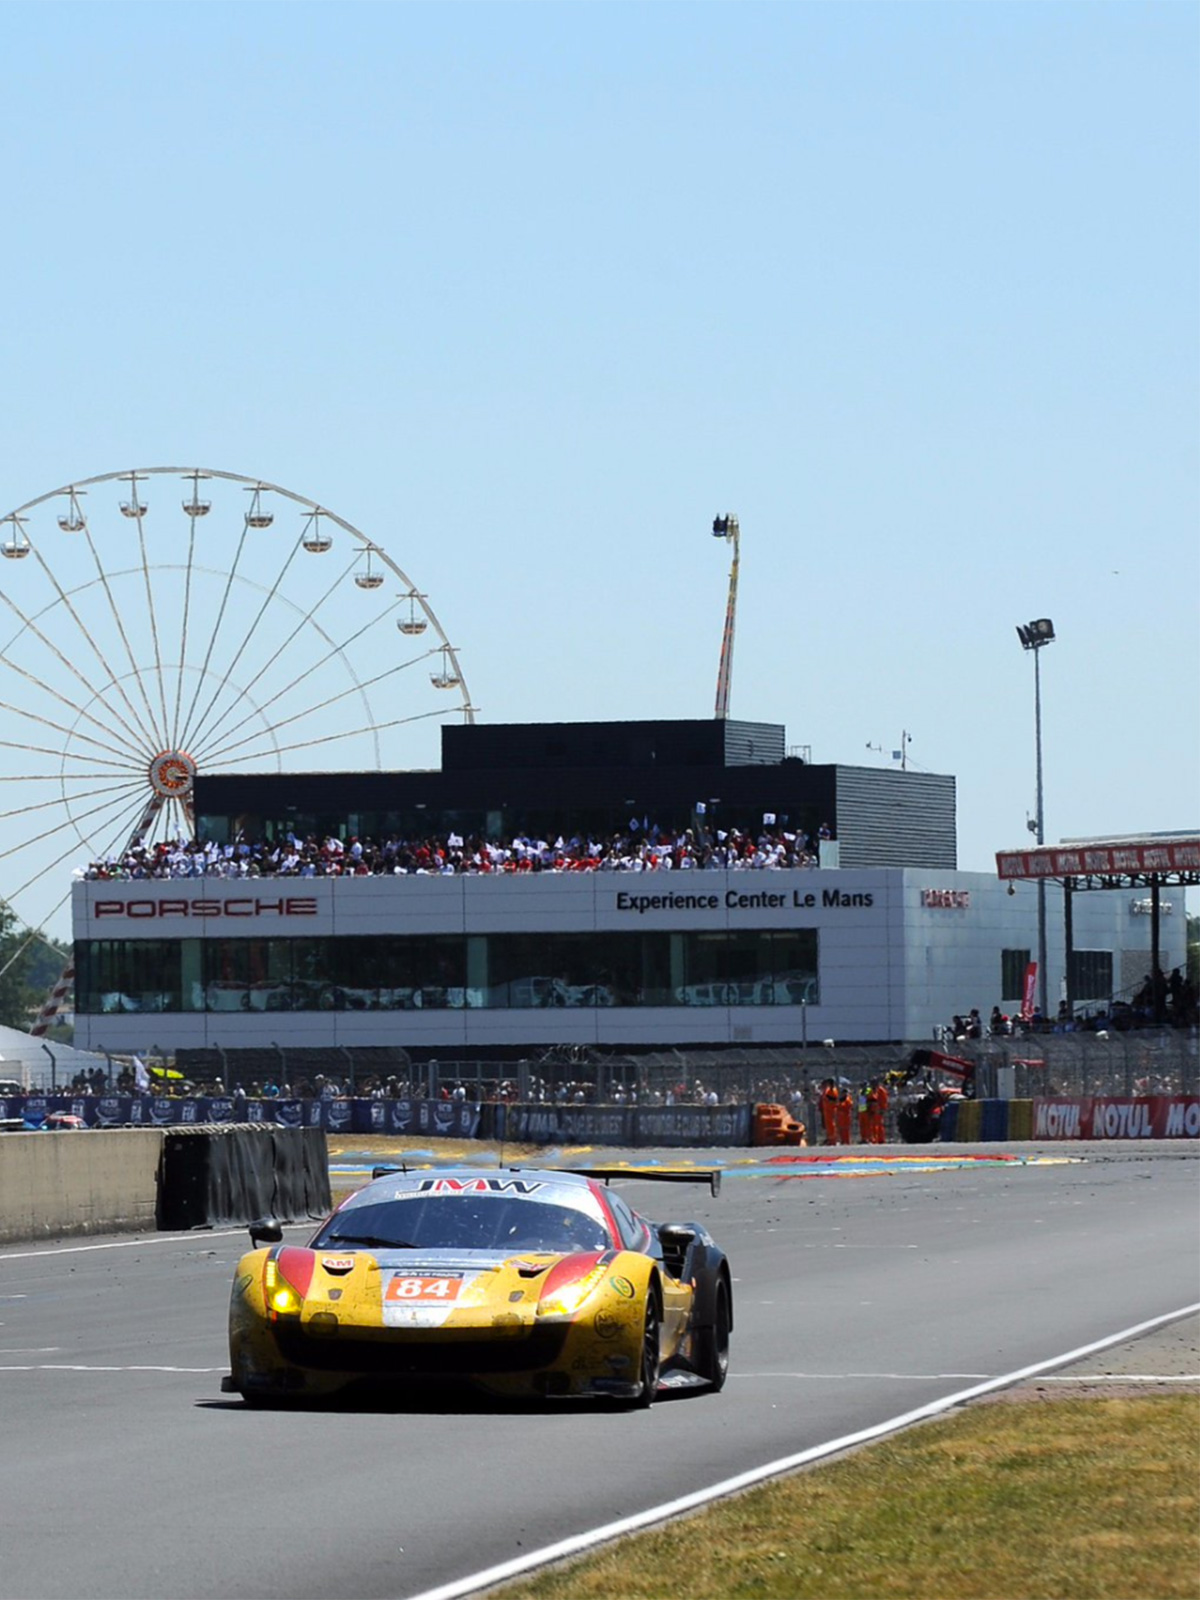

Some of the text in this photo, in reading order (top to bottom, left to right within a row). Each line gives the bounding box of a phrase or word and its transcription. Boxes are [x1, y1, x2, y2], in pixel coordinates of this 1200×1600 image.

[94, 898, 318, 918] PORSCHE
[616, 889, 874, 914] Experience Center Le Mans
[1036, 1104, 1081, 1137] MOTUL
[1093, 1104, 1152, 1137] MOTUL
[412, 1178, 546, 1195] JMW
[324, 1258, 353, 1267] AM
[395, 1279, 450, 1298] 84
